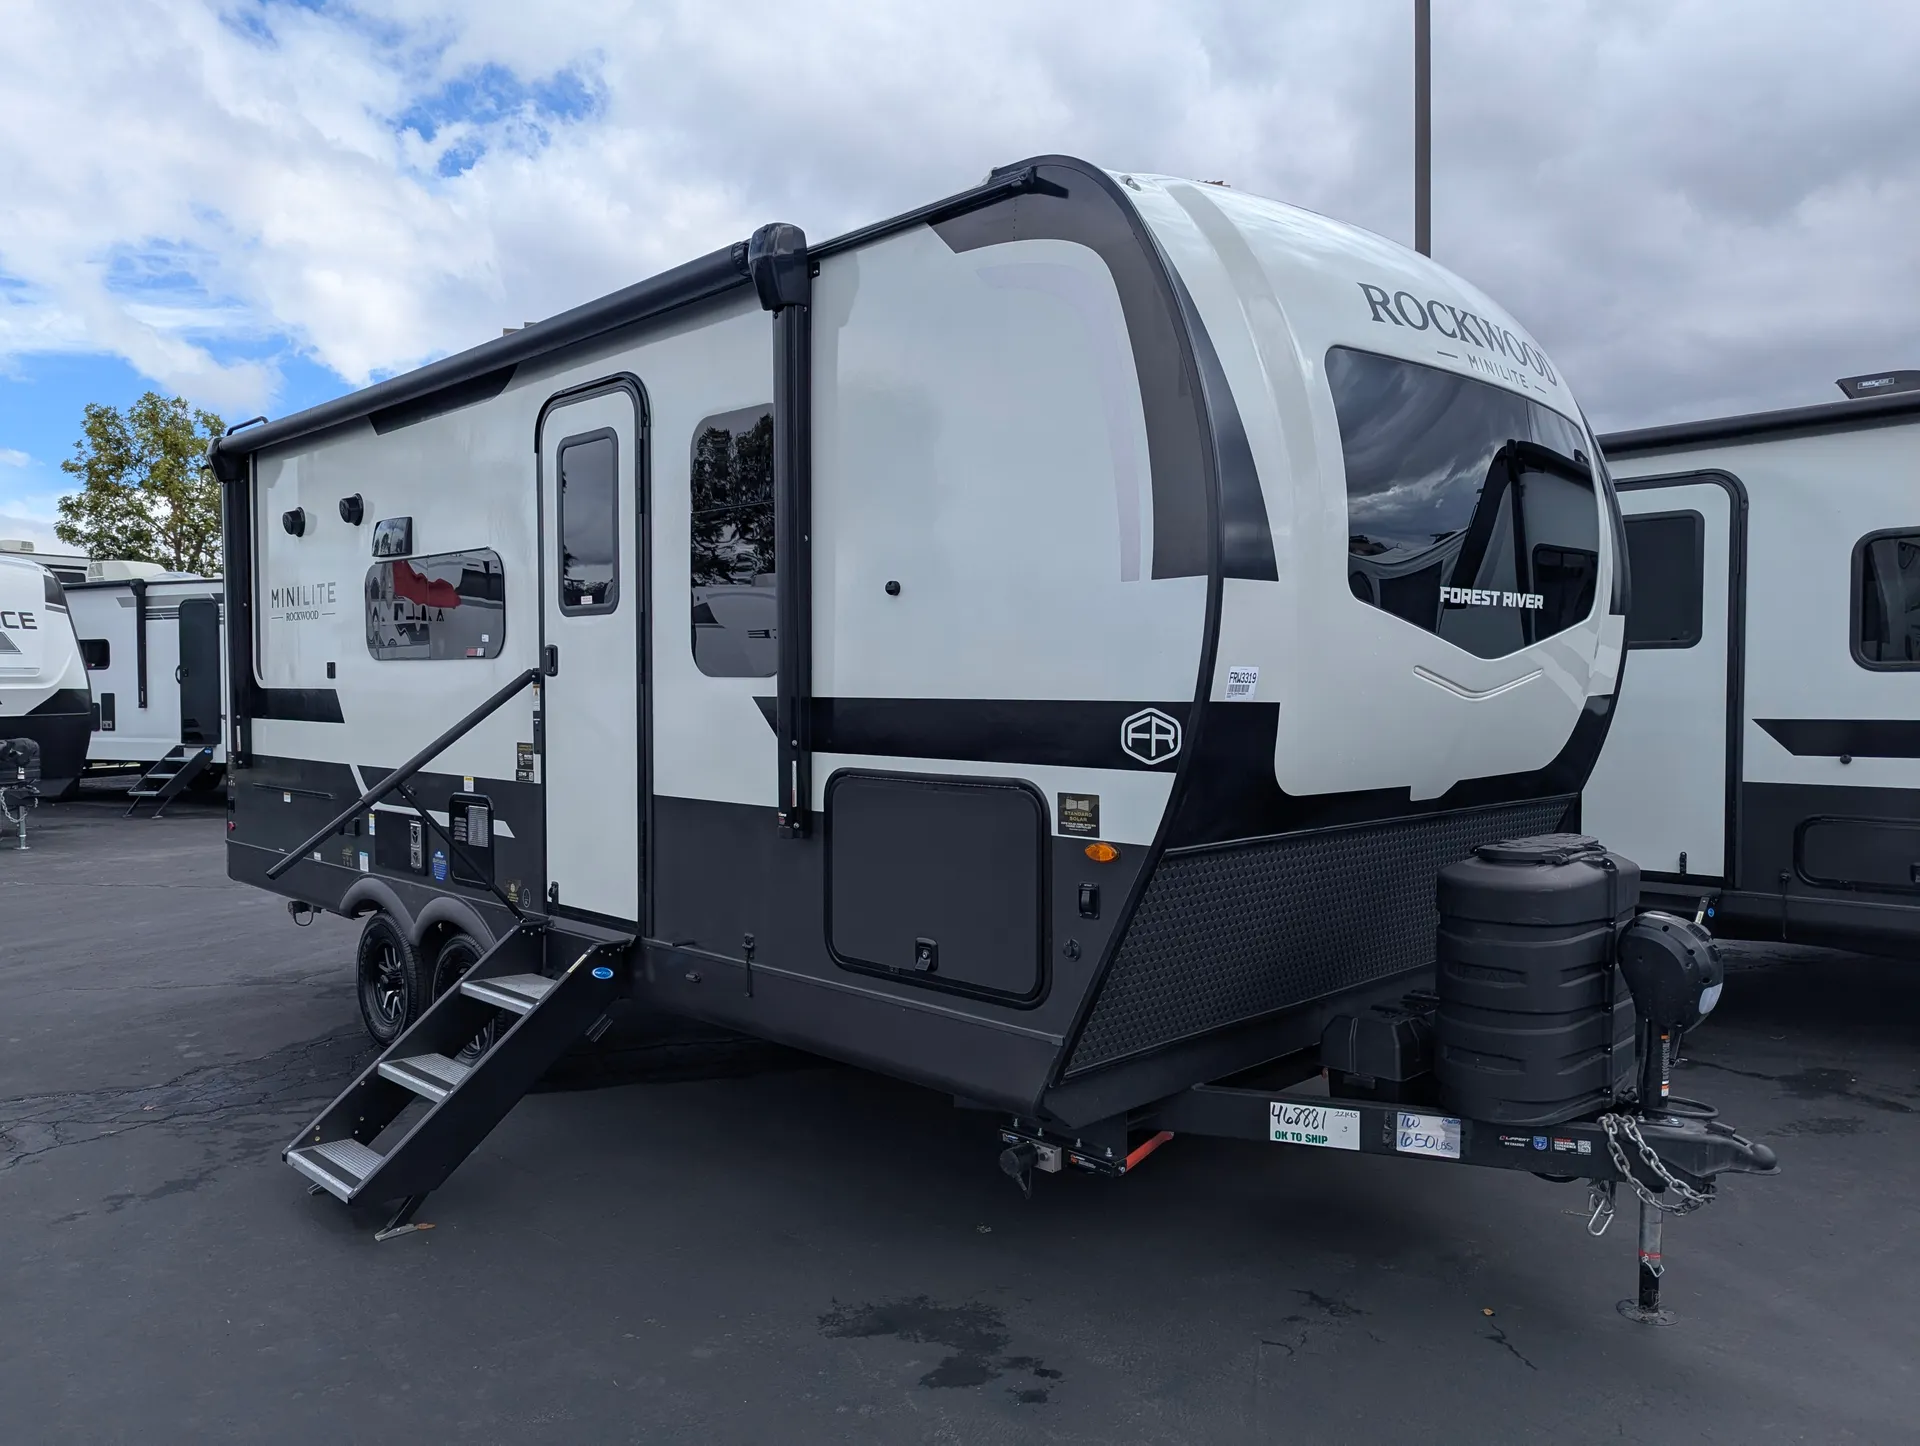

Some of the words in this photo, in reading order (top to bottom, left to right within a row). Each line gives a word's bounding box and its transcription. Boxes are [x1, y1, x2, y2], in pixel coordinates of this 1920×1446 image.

[1356, 282, 1558, 387] ROCKWOOD
[1467, 354, 1529, 389] MINILITE
[271, 582, 336, 609] MINILITE
[1440, 586, 1501, 606] FOREST
[1502, 591, 1544, 609] RIVER
[0, 611, 38, 630] CE
[286, 610, 319, 621] ROCKWOOD
[1229, 671, 1258, 684] FRW3319
[1271, 1104, 1327, 1130] 468881
[1275, 1130, 1288, 1140] OK
[1291, 1132, 1304, 1142] TO
[1305, 1133, 1328, 1144] SHIP
